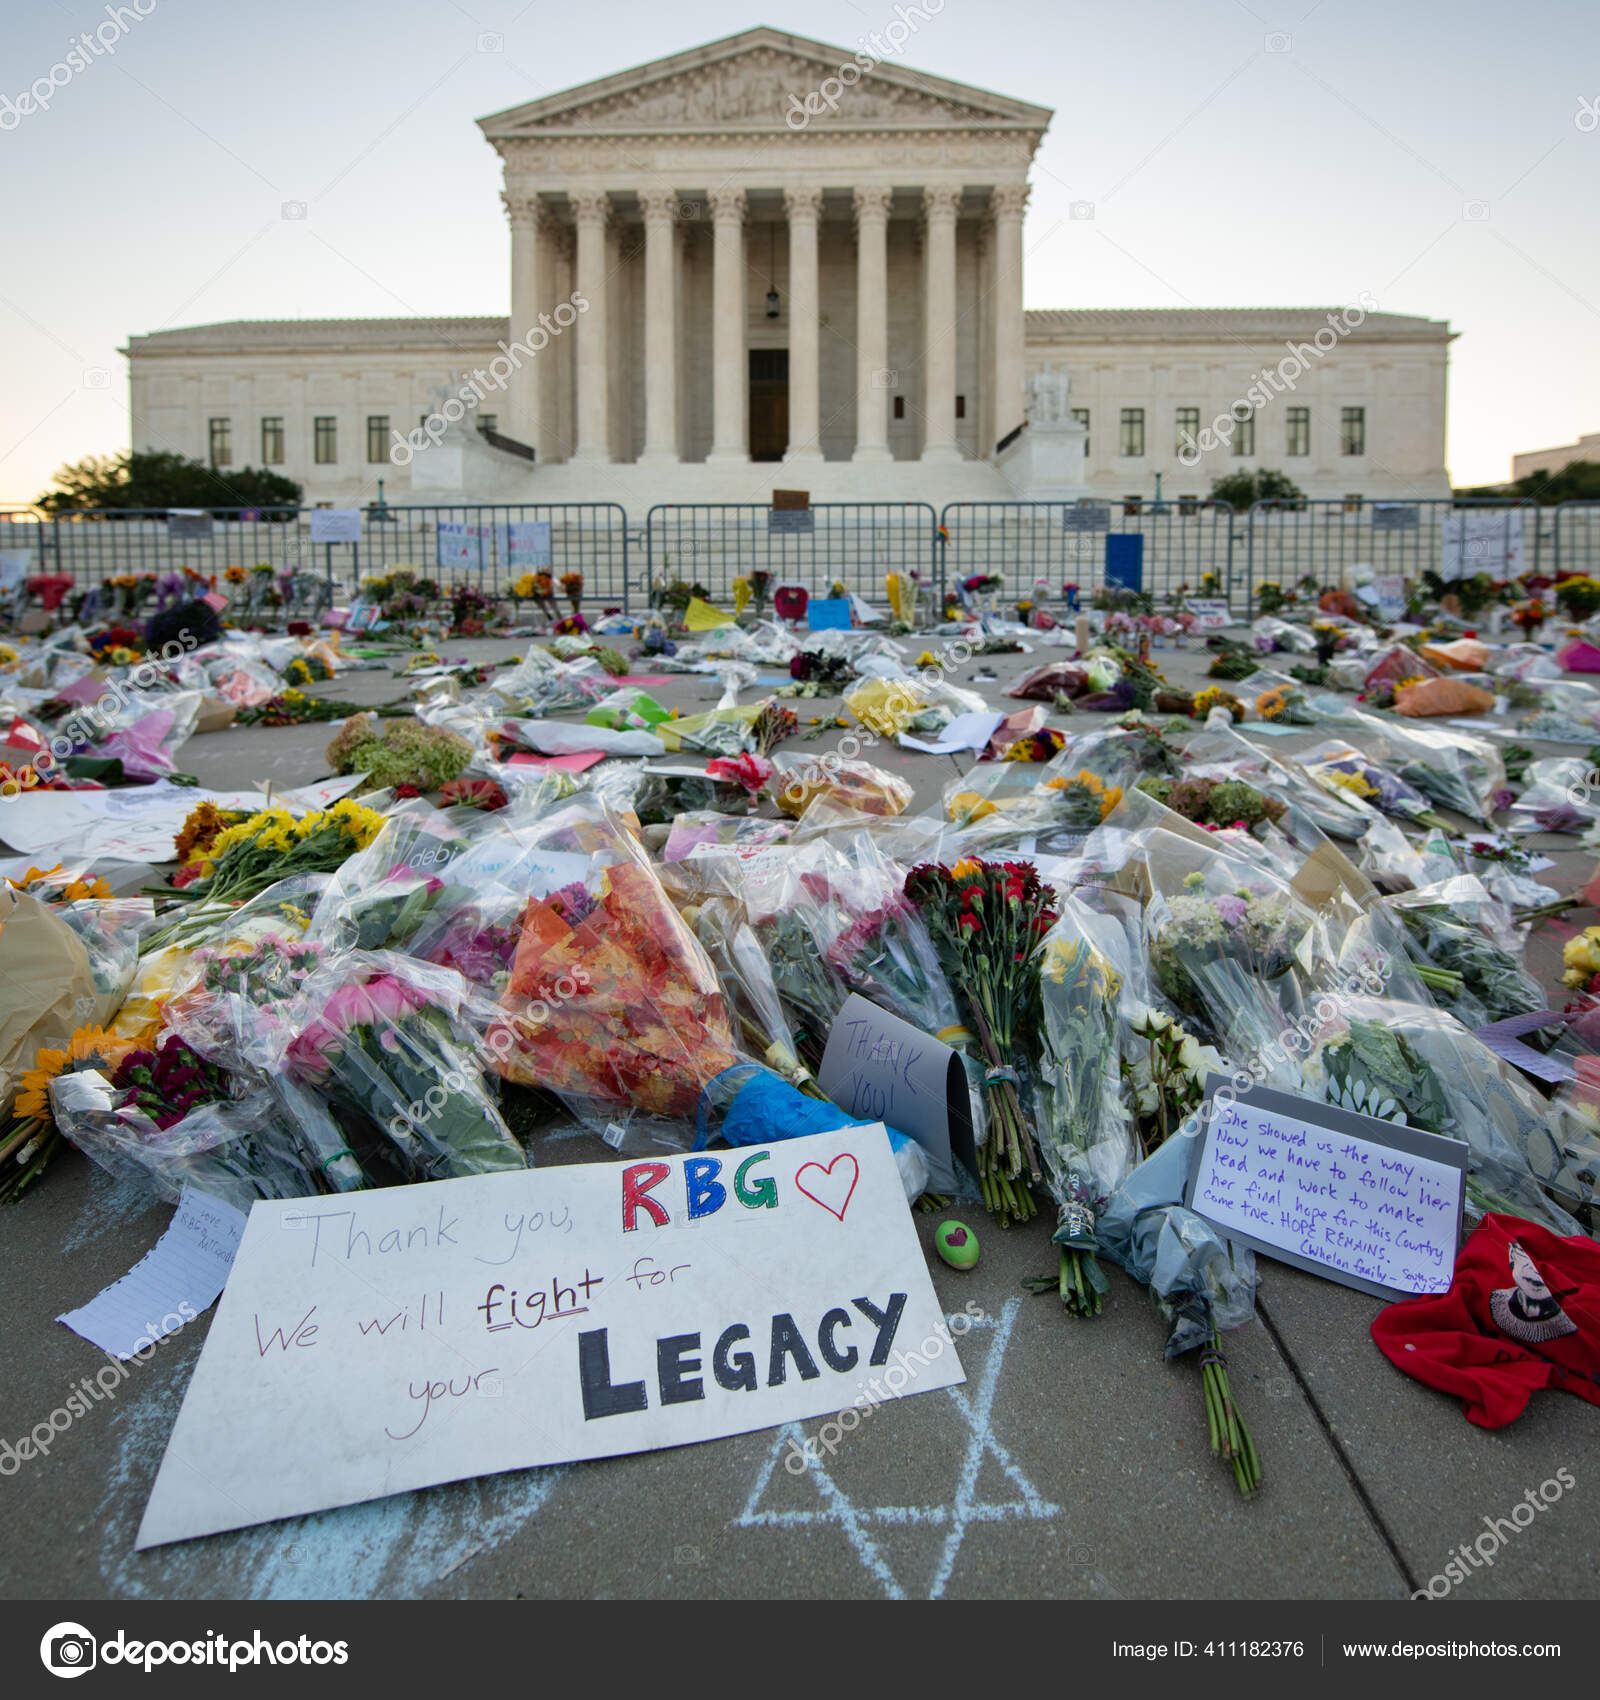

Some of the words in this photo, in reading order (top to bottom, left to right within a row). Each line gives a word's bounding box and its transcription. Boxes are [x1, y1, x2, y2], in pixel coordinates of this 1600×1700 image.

[409, 845, 459, 869] debi
[846, 1019, 924, 1095] THANK
[1216, 1128, 1248, 1148] Now
[1258, 1144, 1277, 1160] we
[1287, 1147, 1320, 1171] have
[1329, 1161, 1347, 1180] to
[1358, 1170, 1409, 1197] follow
[1419, 1187, 1451, 1211] her
[1223, 1108, 1248, 1130] She
[1317, 1142, 1333, 1155] us
[1340, 1144, 1369, 1164] the
[284, 1204, 459, 1268] Thank
[474, 1206, 574, 1265] you,
[622, 1150, 779, 1233] RBG
[1210, 1168, 1235, 1190] her
[1244, 1180, 1281, 1206] final
[1295, 1196, 1328, 1224] hope
[1332, 1208, 1359, 1227] for
[1365, 1219, 1391, 1242] this
[1215, 1147, 1248, 1173] lead
[1257, 1168, 1285, 1183] and
[1298, 1178, 1338, 1200] work
[1348, 1191, 1368, 1210] to
[1378, 1202, 1424, 1227] make
[1203, 1189, 1234, 1209] come
[1280, 1211, 1316, 1239] HOPE
[1325, 1227, 1391, 1264] REMAINS.
[255, 1305, 319, 1357] We
[358, 1290, 444, 1335] will
[477, 1268, 604, 1330] fight
[625, 1257, 692, 1290] for
[384, 1368, 499, 1440] your
[578, 1292, 908, 1421] LEGACY
